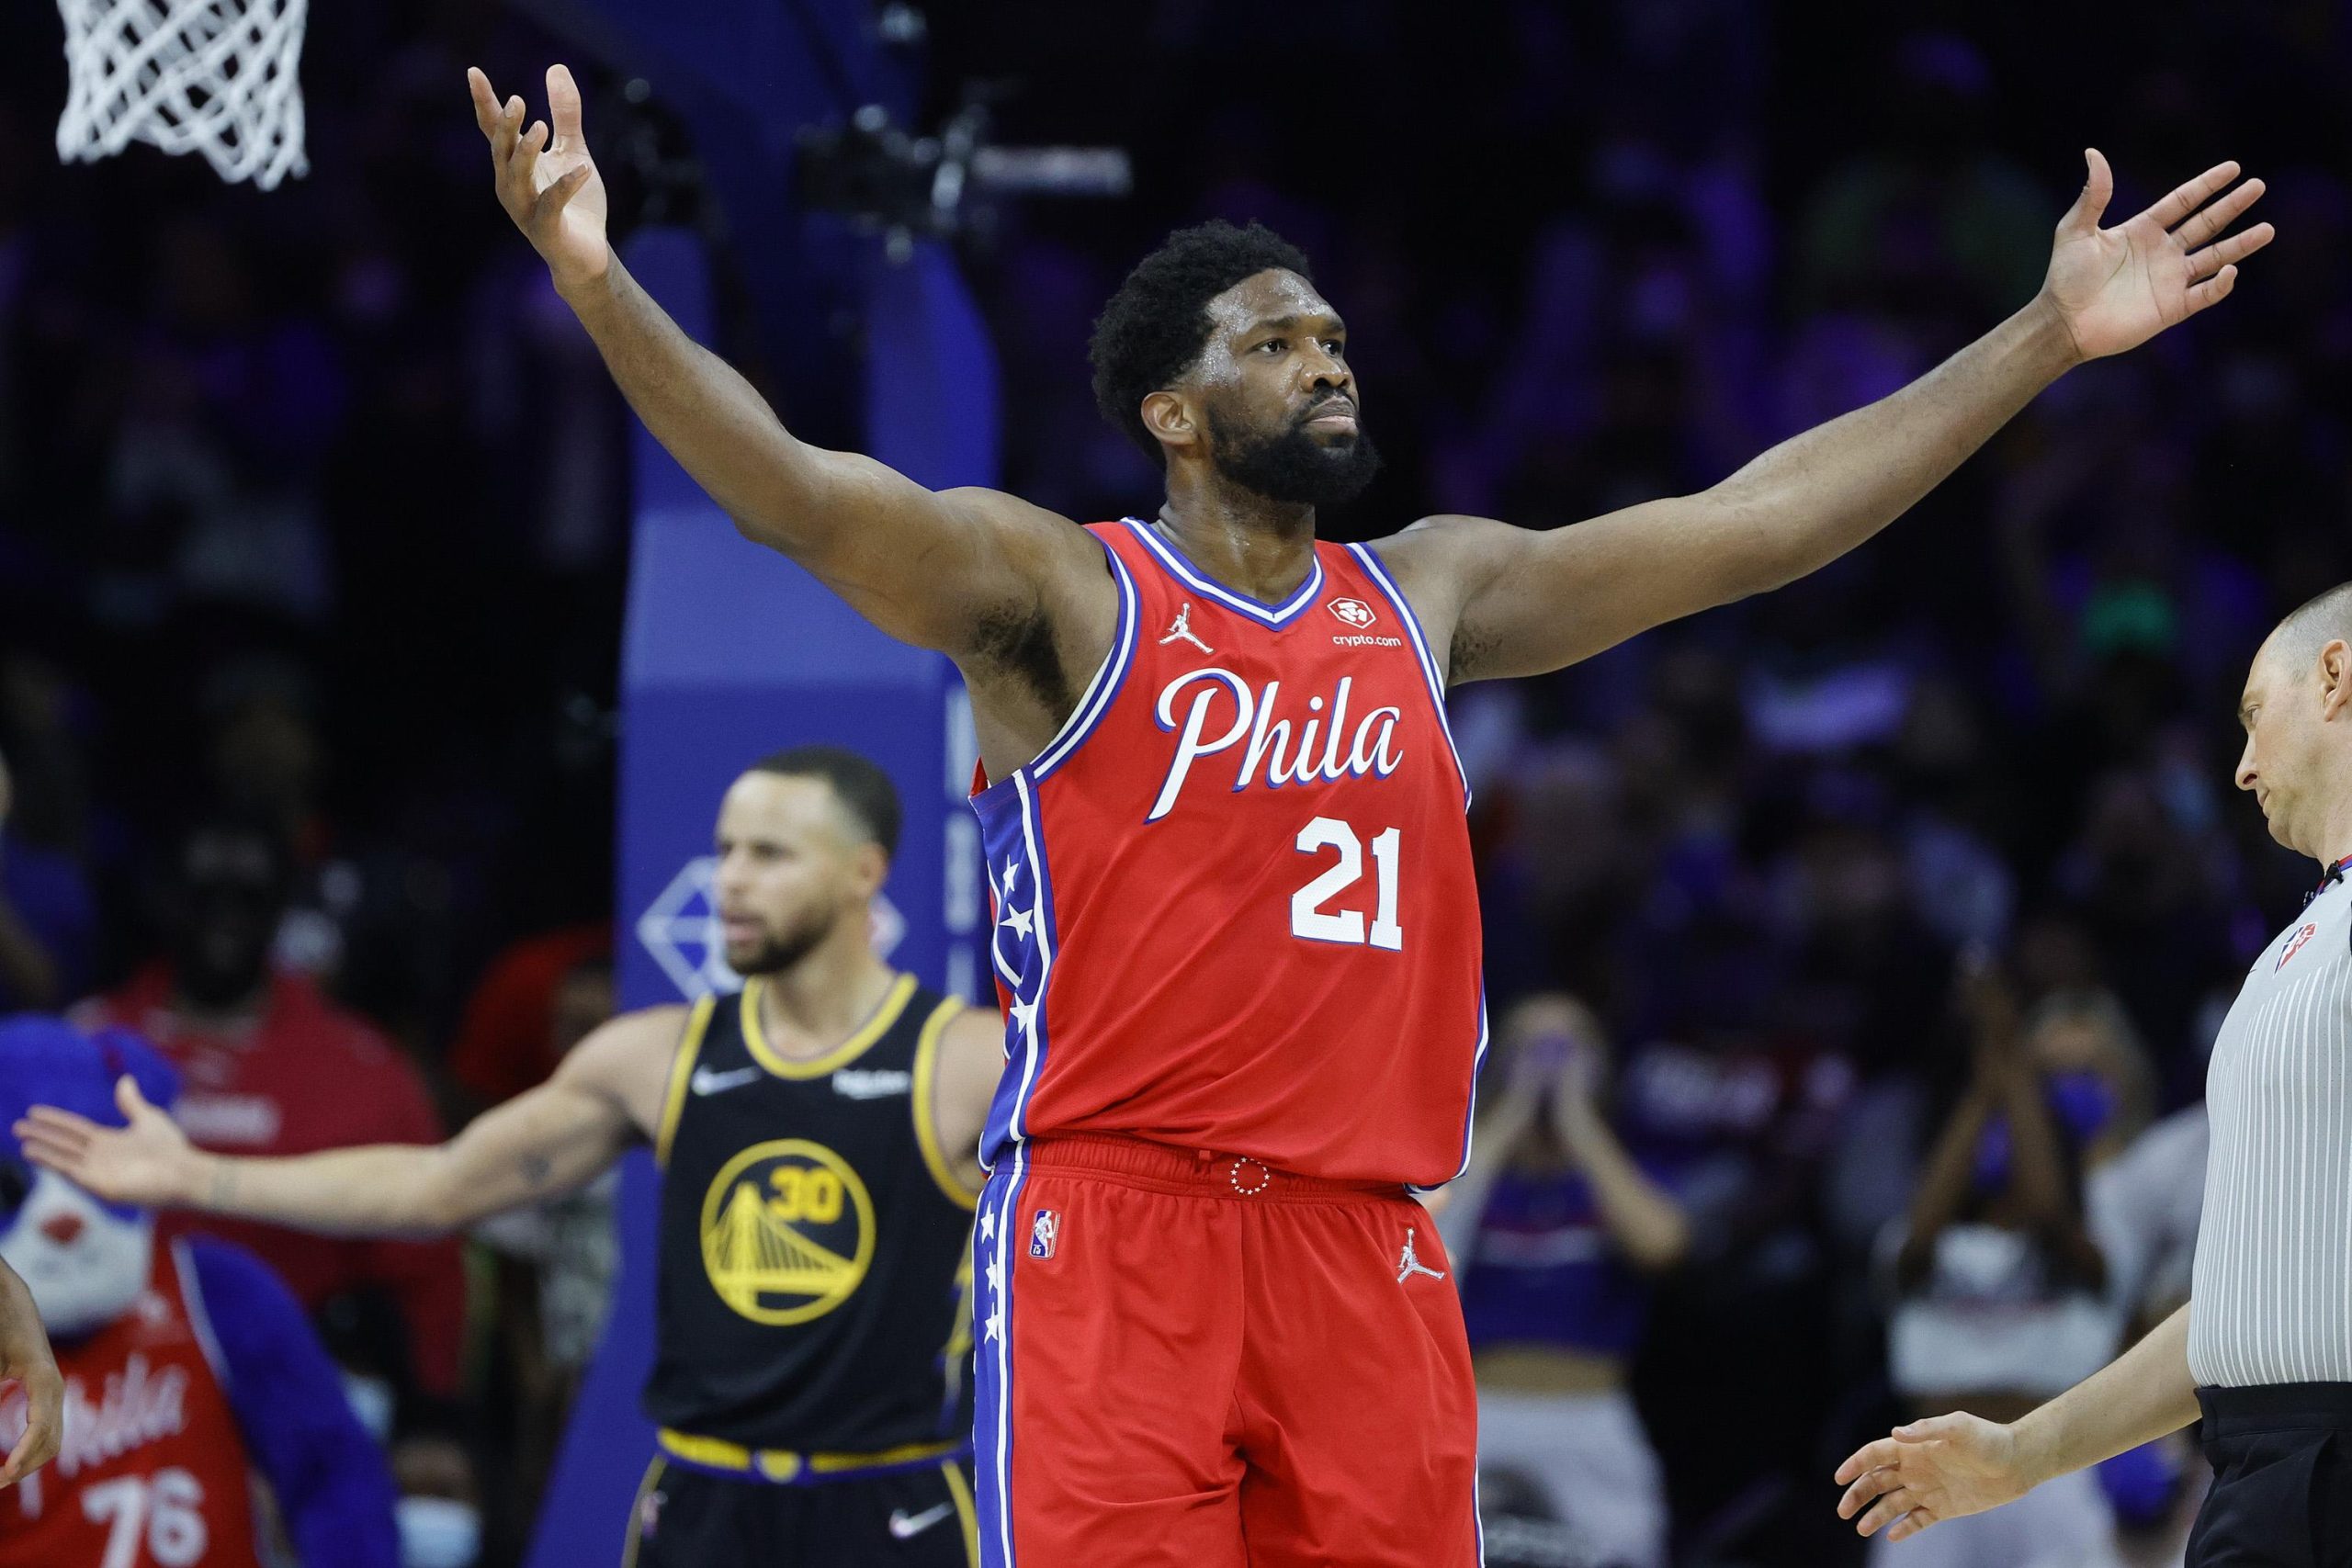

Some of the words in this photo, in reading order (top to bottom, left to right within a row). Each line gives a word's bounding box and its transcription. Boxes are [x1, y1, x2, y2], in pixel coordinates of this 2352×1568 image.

[1331, 634, 1402, 647] crypto.com
[1144, 667, 1404, 825] Phila
[1290, 816, 1402, 953] 21
[769, 1164, 843, 1224] 30
[1032, 1244, 1043, 1256] 75
[81, 1466, 208, 1568] 76
